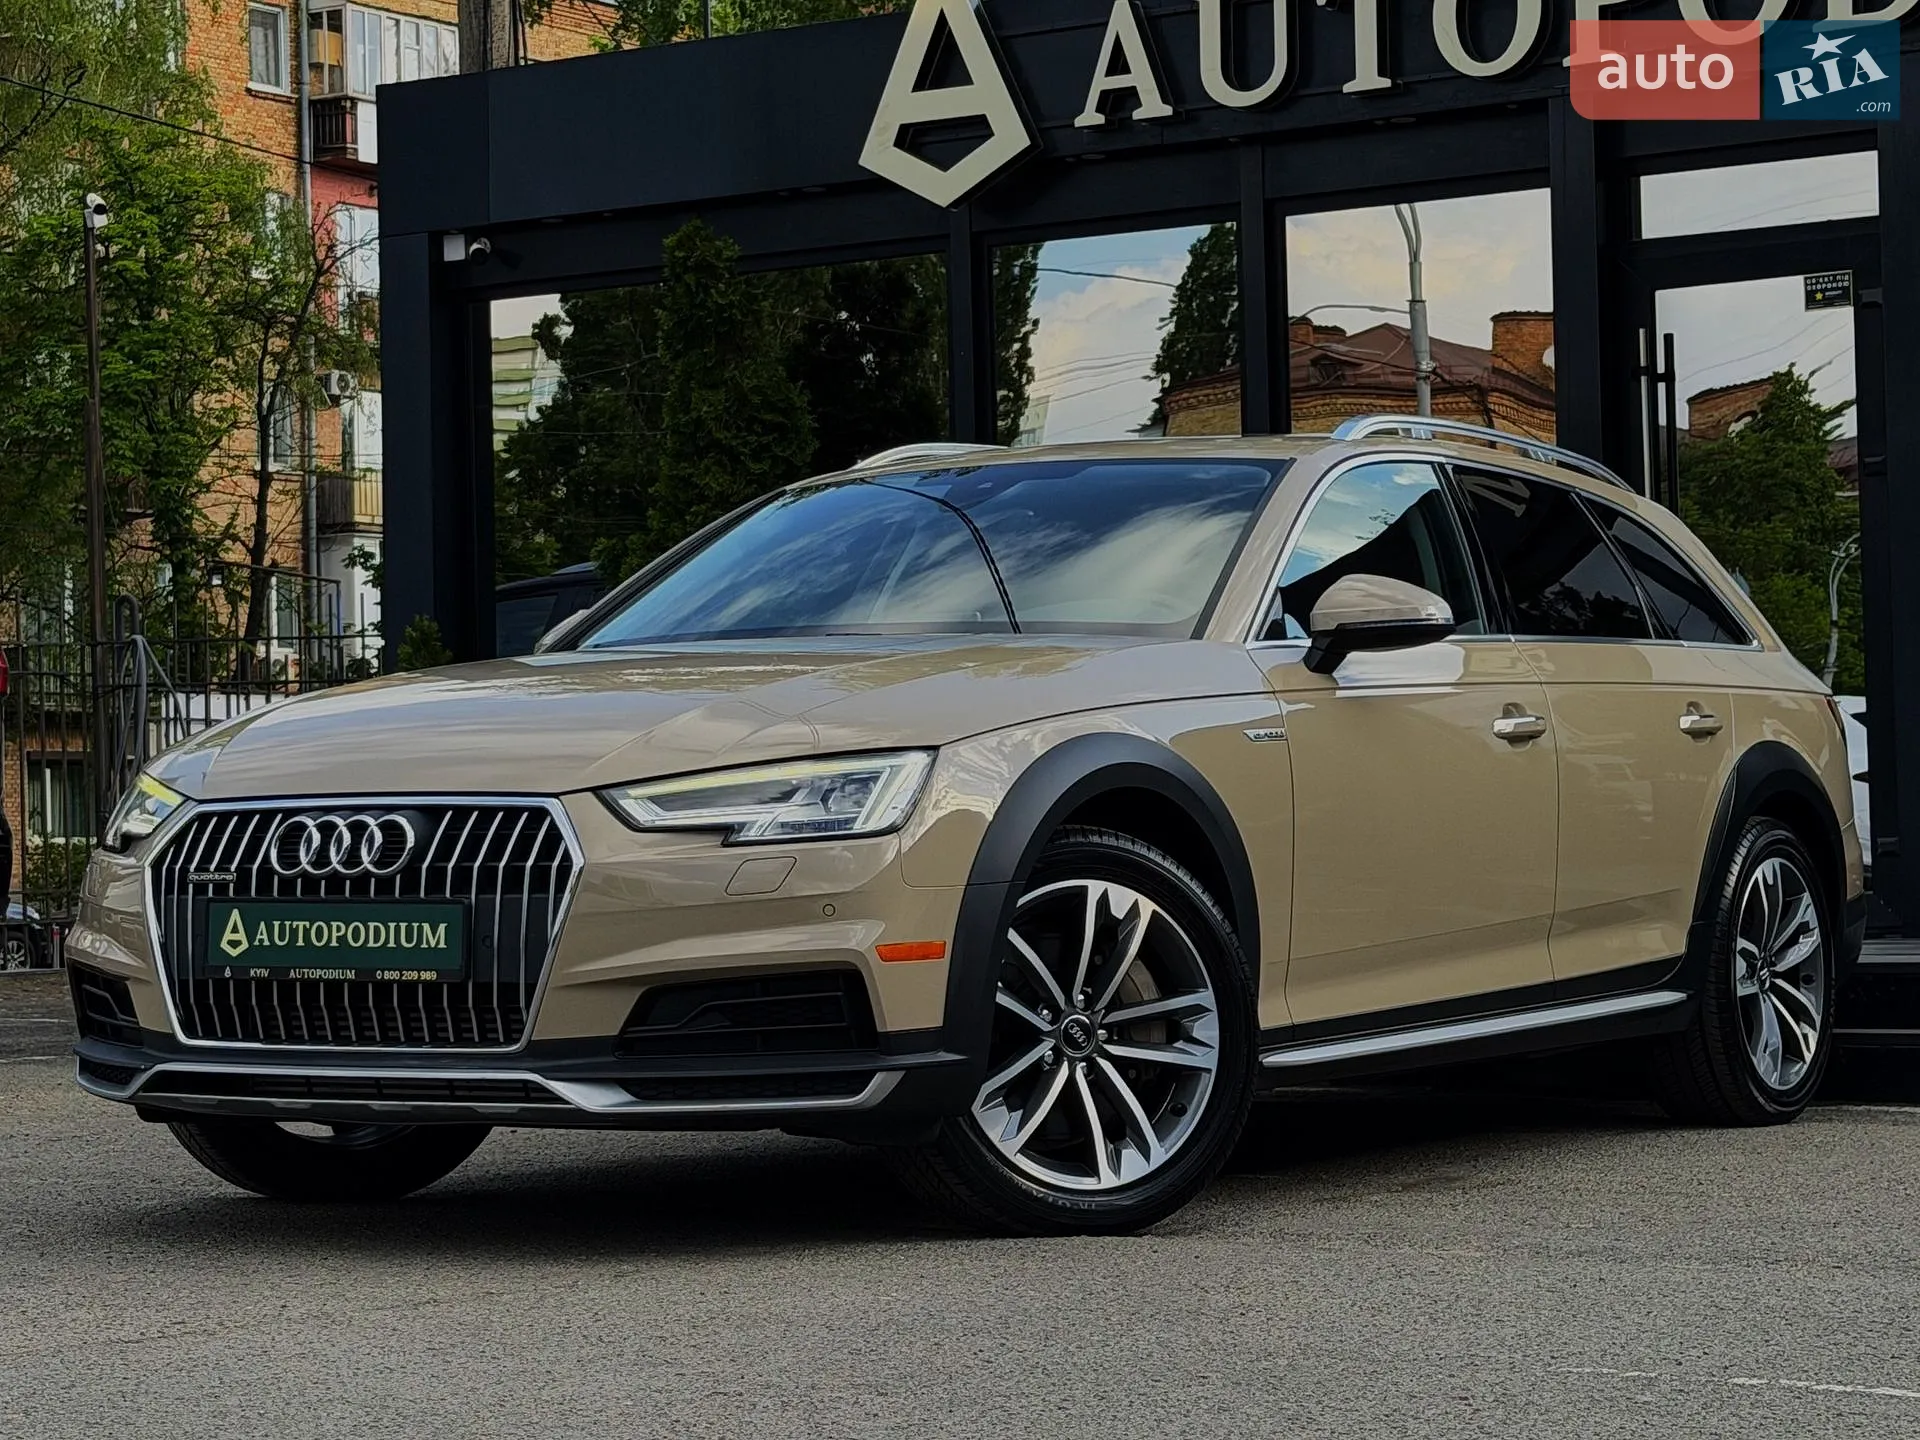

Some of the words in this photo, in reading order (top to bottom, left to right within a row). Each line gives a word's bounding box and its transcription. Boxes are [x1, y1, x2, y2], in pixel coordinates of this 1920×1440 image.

[1074, 0, 1919, 127] AUTOP
[189, 873, 234, 882] quattro
[253, 920, 448, 949] AUTOPODIUM
[250, 967, 270, 978] KYIV
[289, 968, 356, 979] AUTOPODIUM
[383, 970, 400, 980] 800
[401, 970, 418, 980] 209
